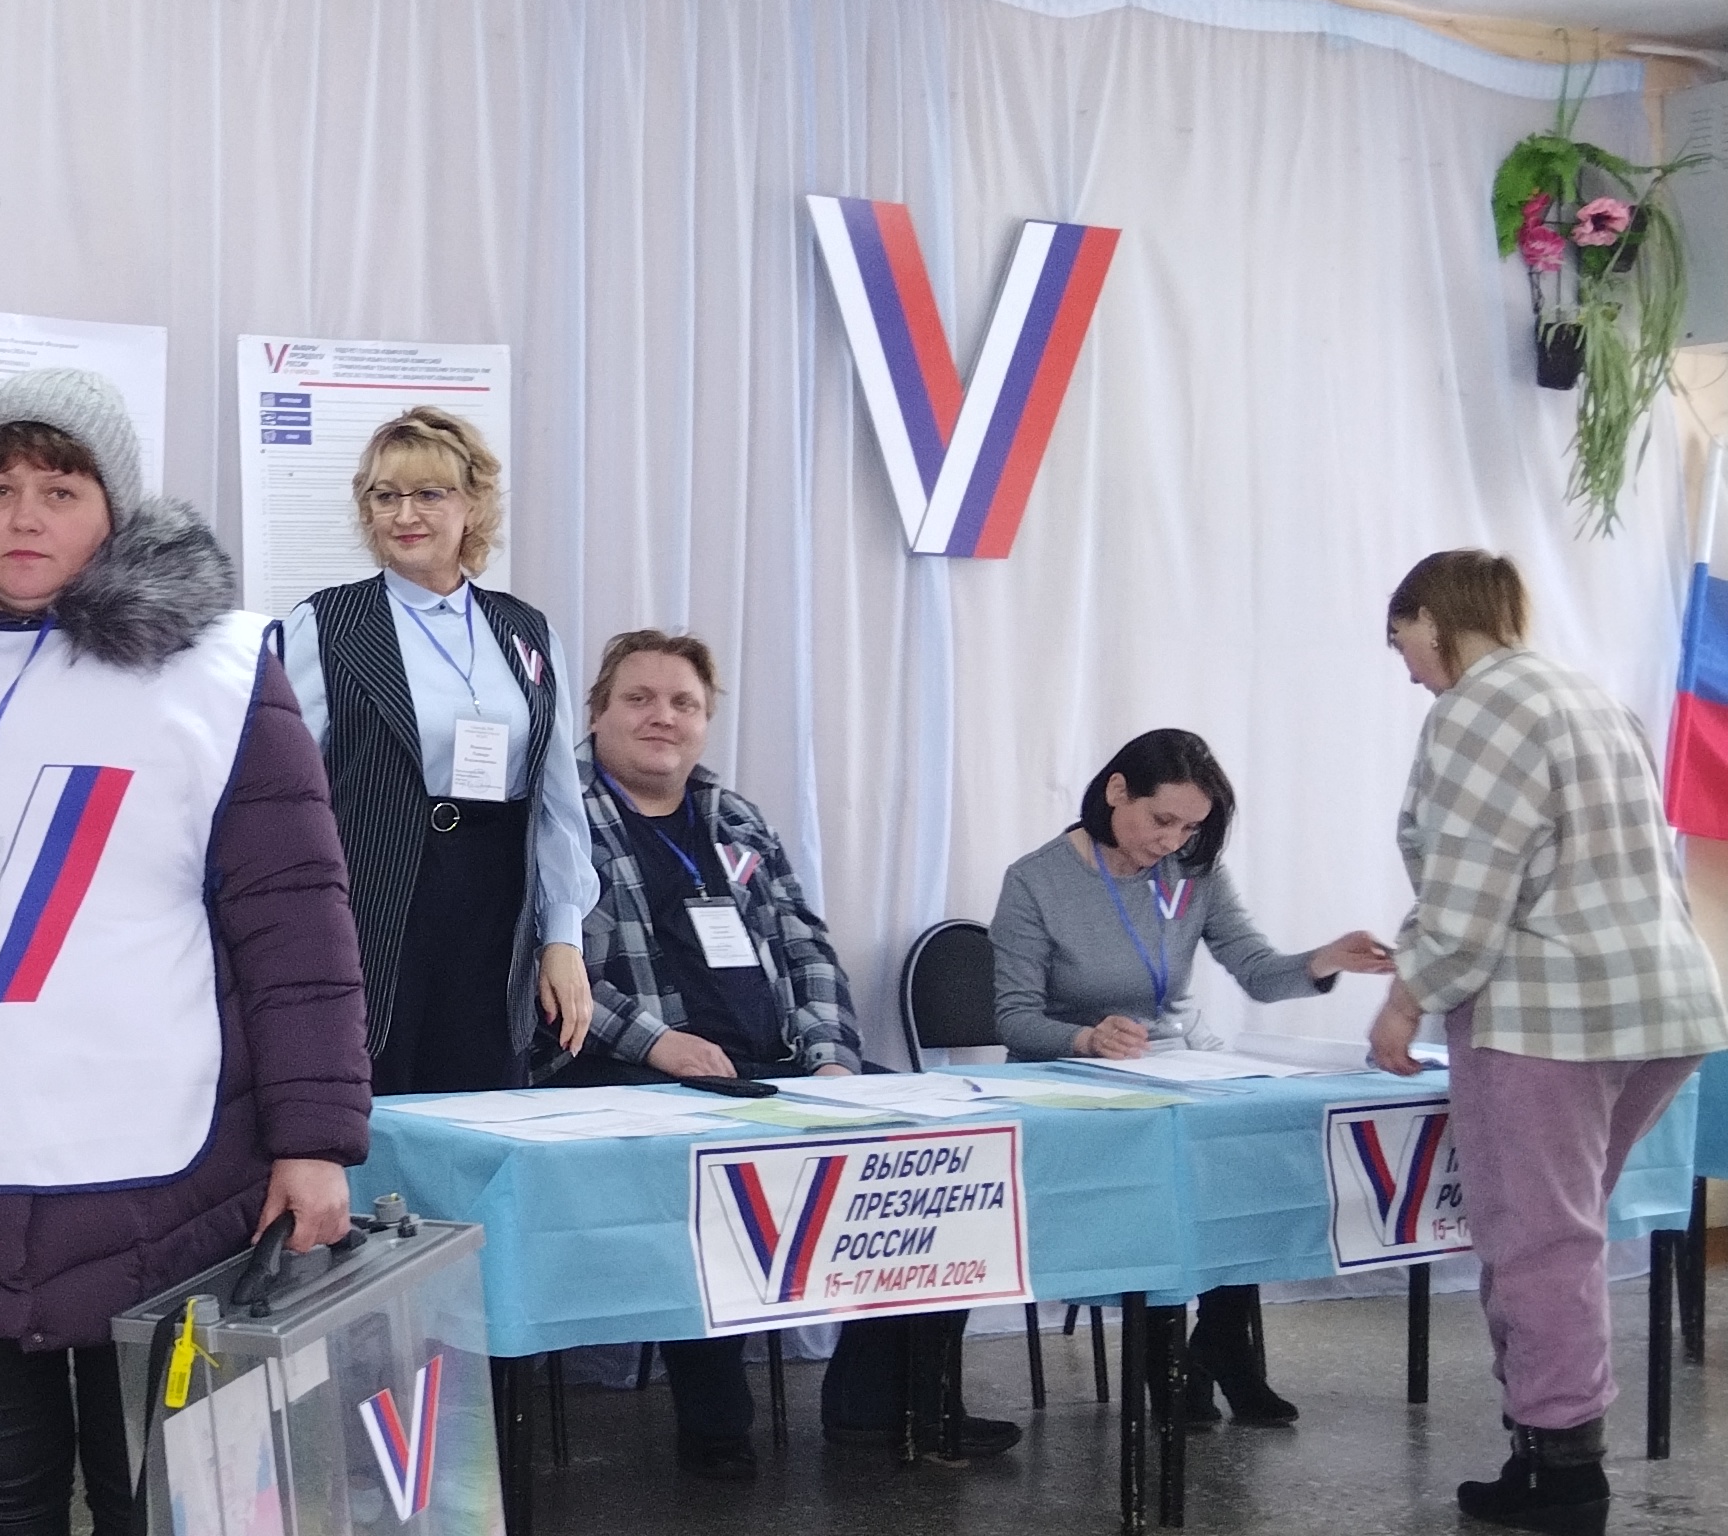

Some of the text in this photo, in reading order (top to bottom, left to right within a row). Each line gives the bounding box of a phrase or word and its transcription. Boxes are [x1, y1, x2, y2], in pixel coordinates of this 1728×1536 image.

[858, 1145, 974, 1182] ВЫБОРЫ
[844, 1181, 1006, 1223] ПРЕЗИДЕНТА
[830, 1226, 938, 1263] РОССИИ
[874, 1263, 939, 1293] МАРТА
[941, 1259, 987, 1287] 2024
